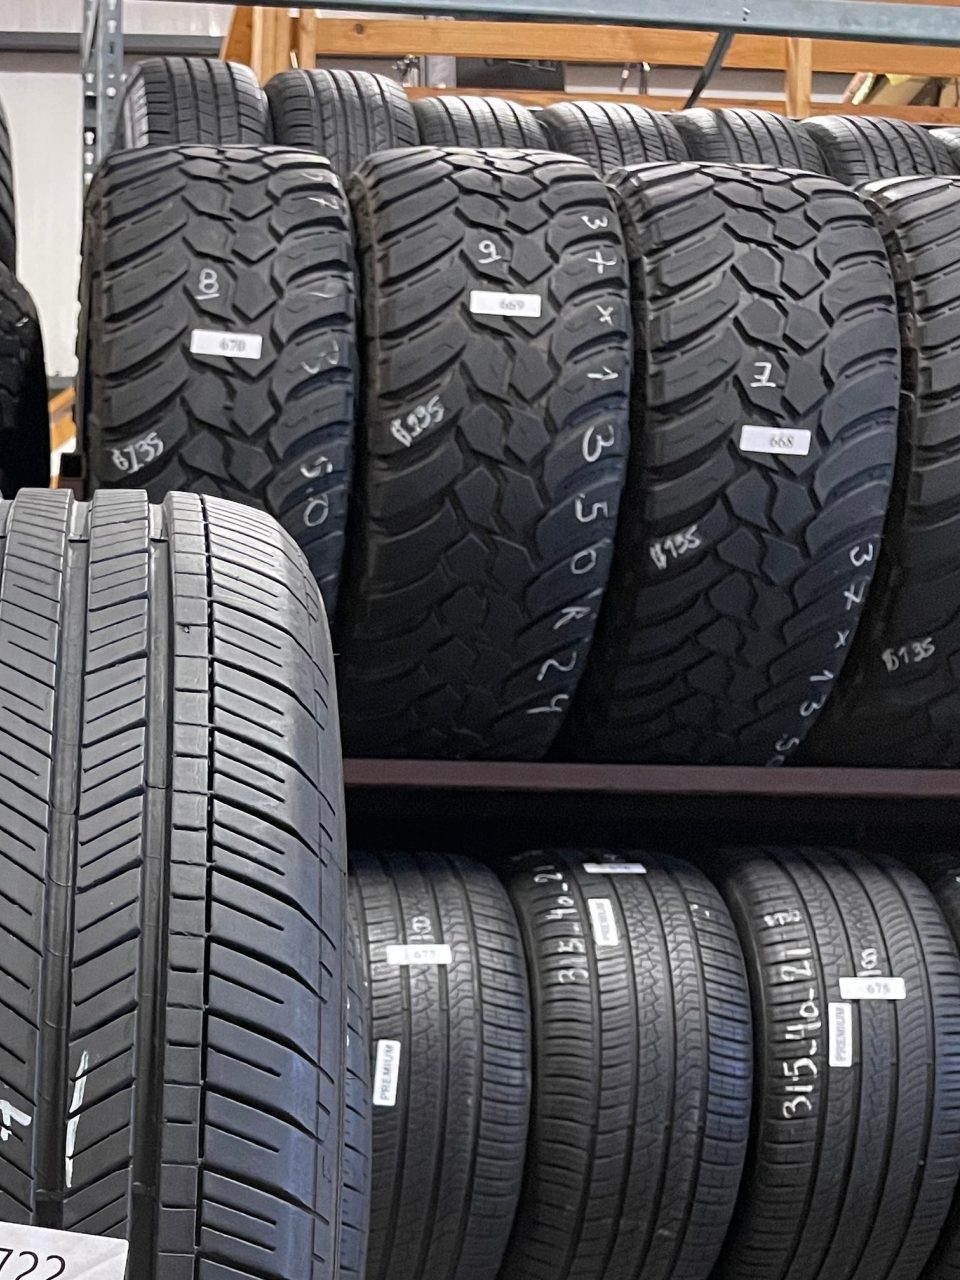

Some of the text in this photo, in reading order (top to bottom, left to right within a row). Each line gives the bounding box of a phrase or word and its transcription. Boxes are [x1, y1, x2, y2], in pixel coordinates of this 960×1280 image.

[478, 239, 497, 260] 9
[199, 267, 220, 294] 8
[499, 298, 526, 312] 669
[220, 338, 246, 353] 670
[769, 433, 794, 448] 668
[781, 948, 822, 1119] 315-40-21
[835, 1006, 846, 1062] PREMIUM
[379, 1042, 396, 1101] PREMIUM
